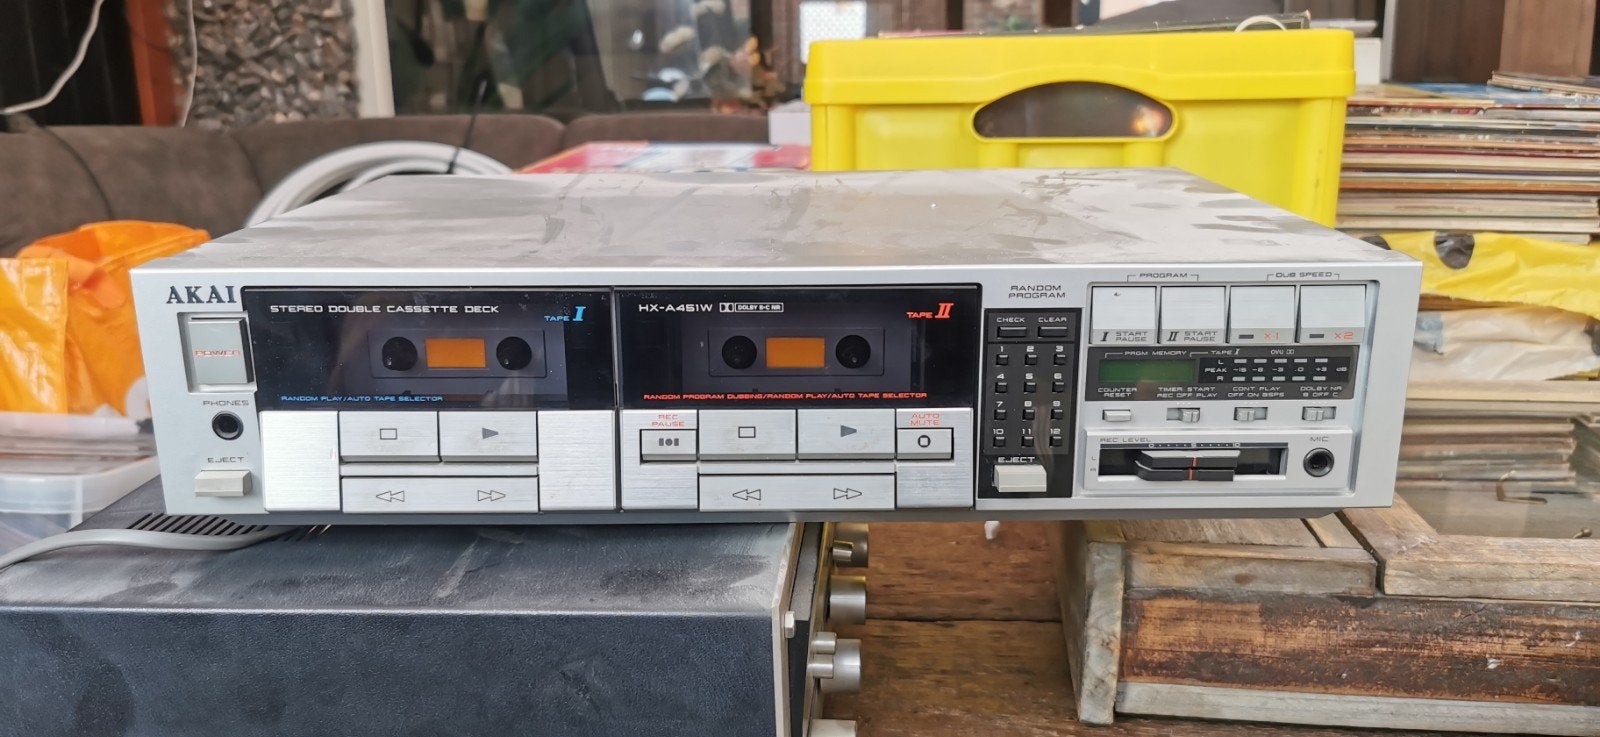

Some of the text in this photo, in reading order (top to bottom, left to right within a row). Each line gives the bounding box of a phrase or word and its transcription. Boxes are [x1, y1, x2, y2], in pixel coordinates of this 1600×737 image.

[166, 285, 238, 304] AKAI
[270, 305, 500, 313] STEREO DOUBLE CASSETTE DECK
[572, 306, 587, 322] I
[638, 304, 713, 312] HX-A451W
[907, 302, 954, 319] TAPE II
